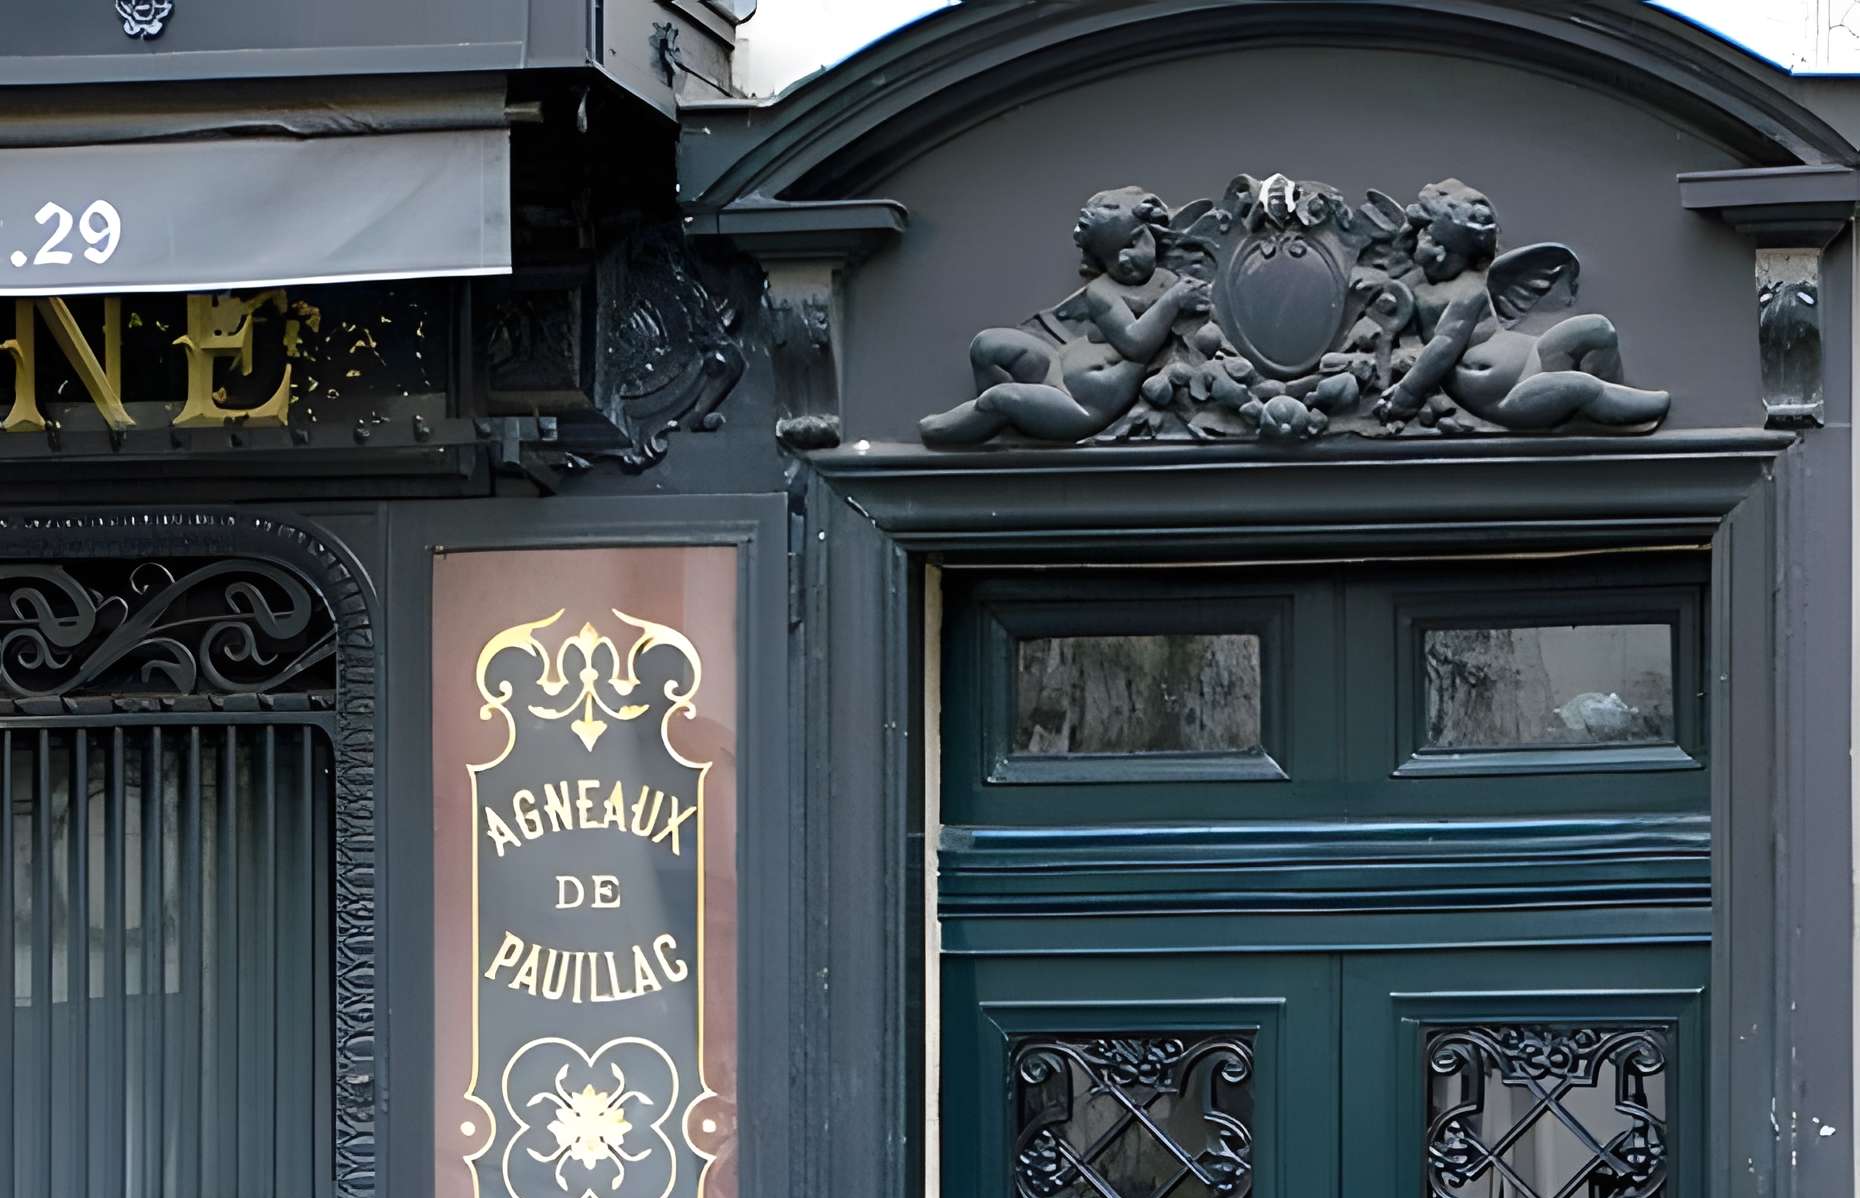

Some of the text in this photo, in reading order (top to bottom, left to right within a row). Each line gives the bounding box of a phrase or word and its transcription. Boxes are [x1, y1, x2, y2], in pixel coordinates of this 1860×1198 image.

[485, 780, 697, 857] AGNEAUX
[555, 875, 621, 909] DE
[485, 931, 688, 1004] PAUILLAC
